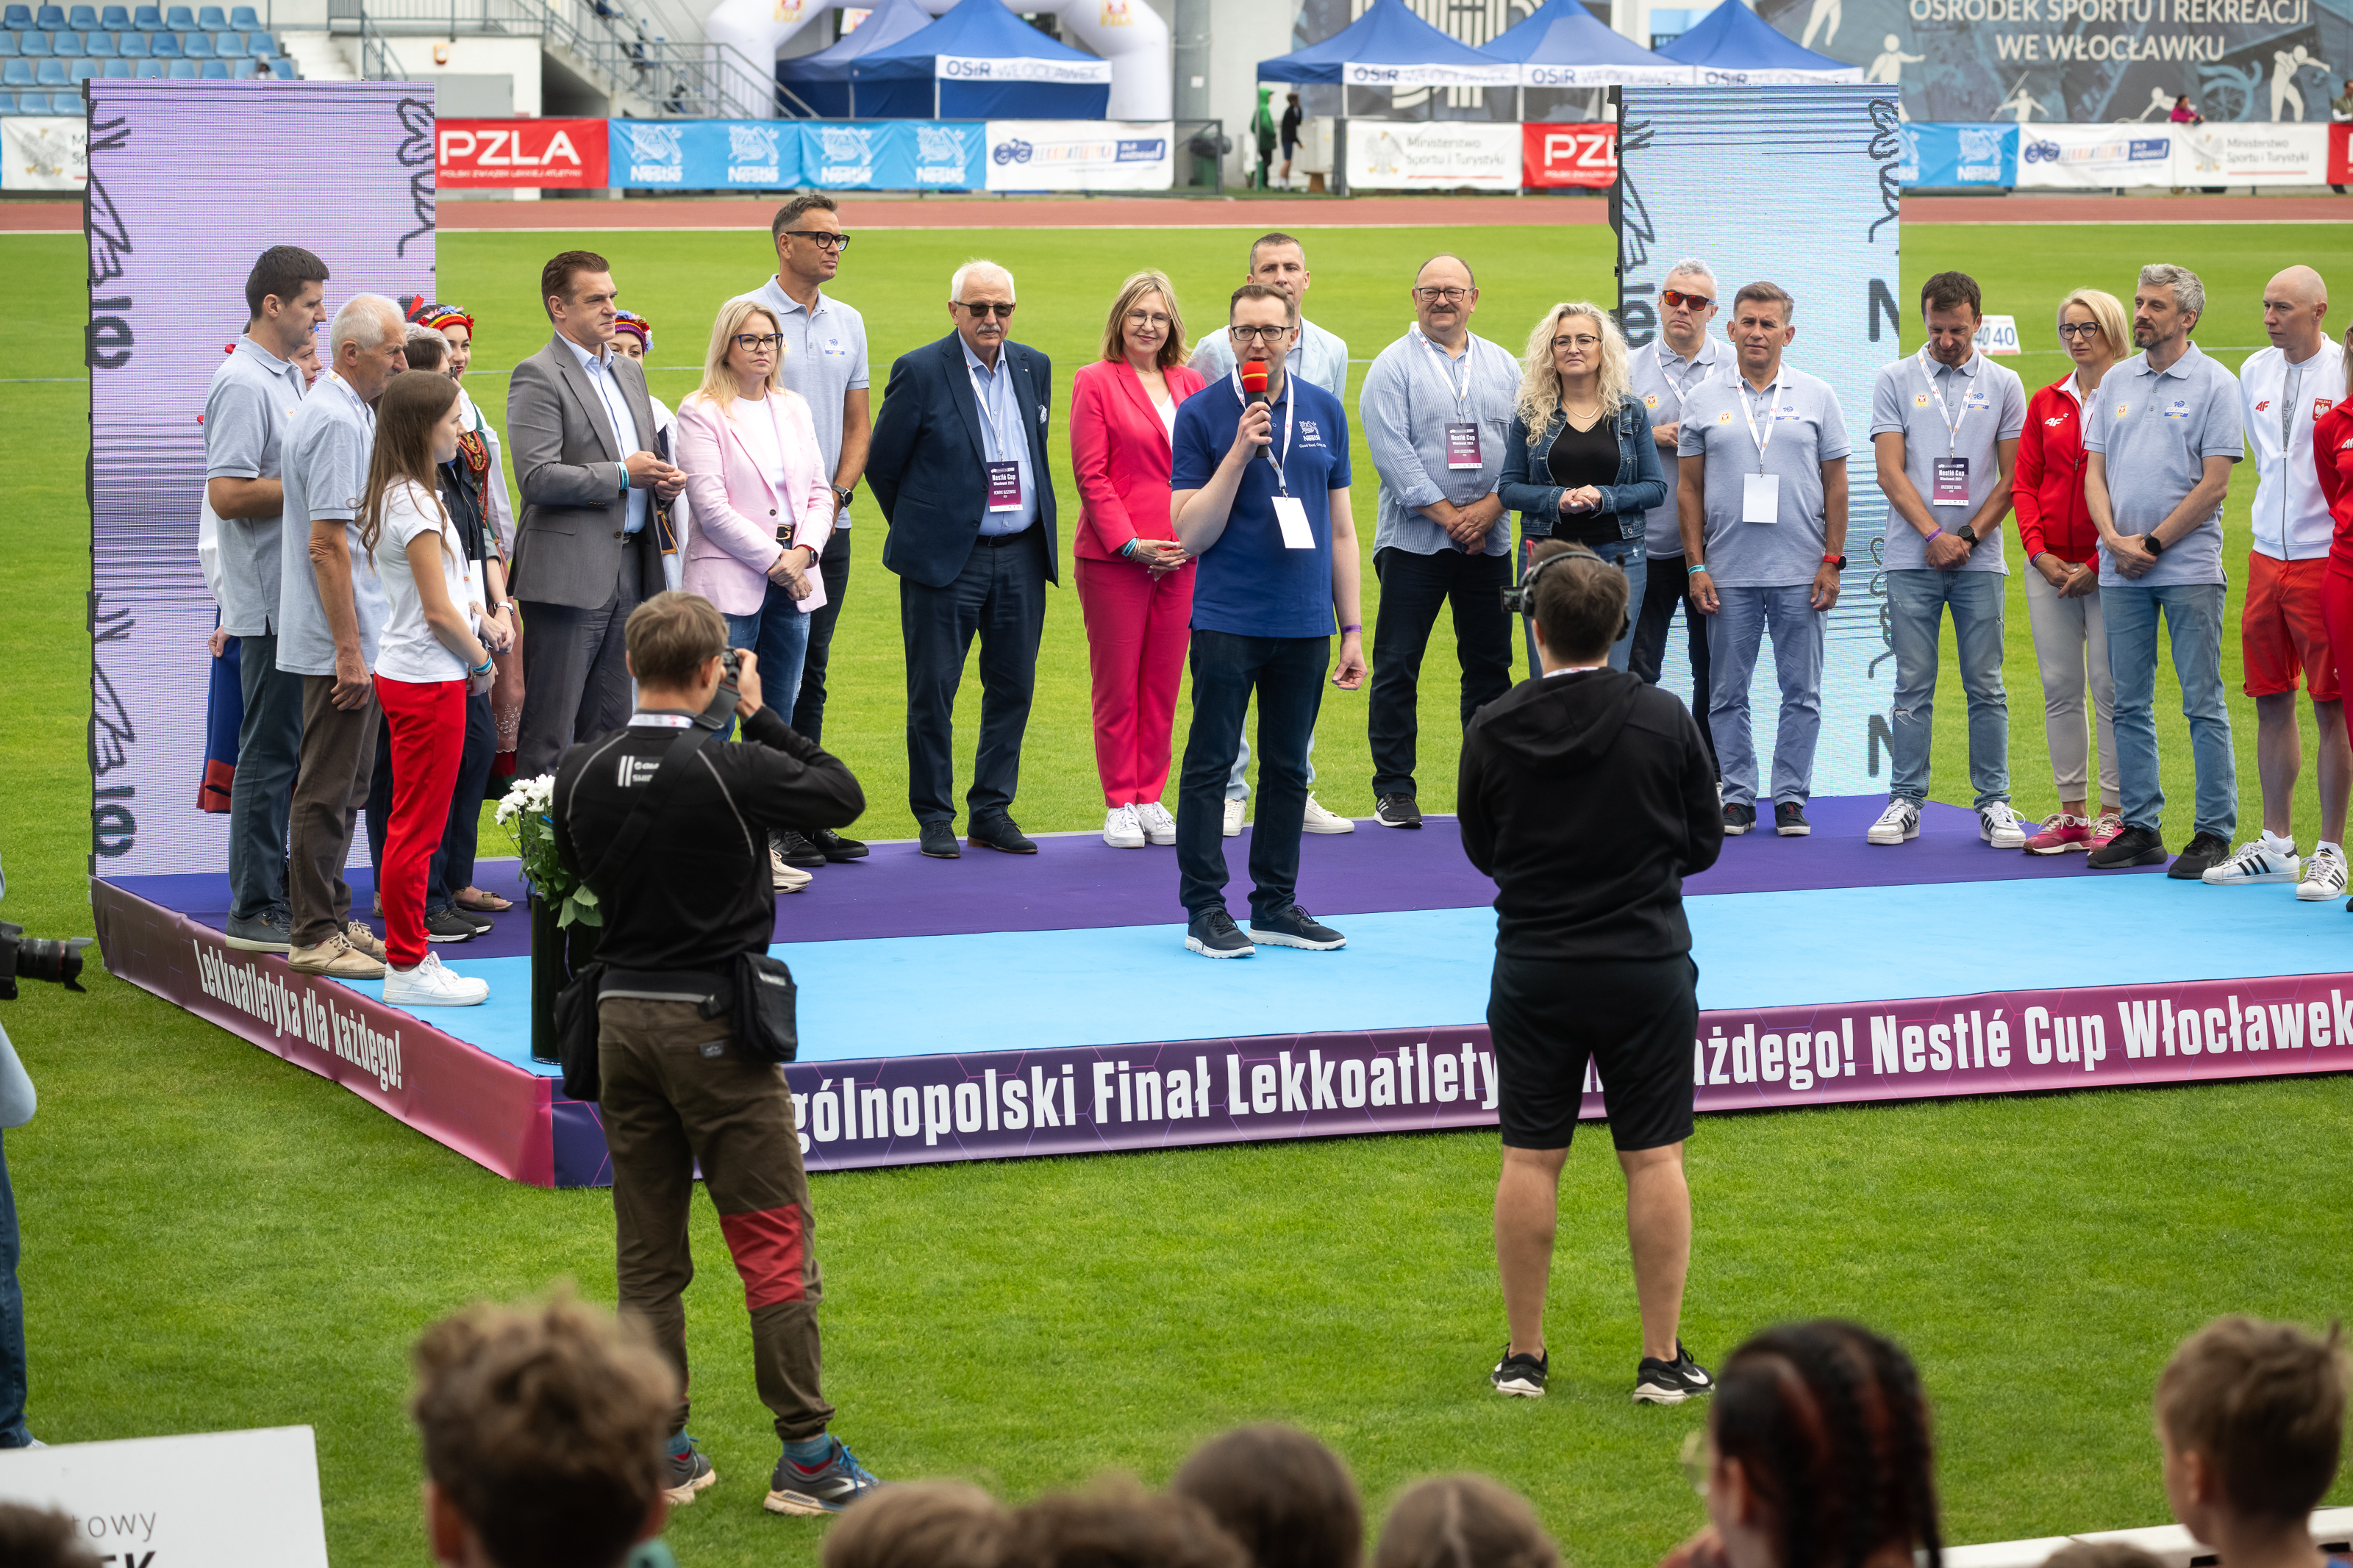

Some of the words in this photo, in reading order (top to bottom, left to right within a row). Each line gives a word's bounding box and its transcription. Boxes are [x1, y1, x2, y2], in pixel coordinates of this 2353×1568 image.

[2047, 0, 2152, 23] SPORTU
[2159, 0, 2165, 23] I
[2174, 0, 2308, 24] REKREACJI
[1996, 34, 2040, 60] WE
[2046, 34, 2225, 62] WŁOCŁAWKU
[440, 130, 582, 166] PZLA
[1544, 133, 1617, 167] PZL
[1993, 326, 2015, 346] 40
[2255, 401, 2270, 411] 4F
[2044, 418, 2063, 426] 4F
[193, 939, 302, 1039] Lekkoatletyka
[302, 987, 329, 1052] dla
[329, 998, 402, 1092] każdego!
[790, 1064, 1076, 1155] gólnopolski
[1093, 1056, 1211, 1124] Finał
[1227, 1042, 1499, 1116] Lekkoatlety
[1870, 1009, 2011, 1075] Nestlé
[2024, 1006, 2107, 1072] Cup
[2117, 989, 2353, 1059] Włocławek
